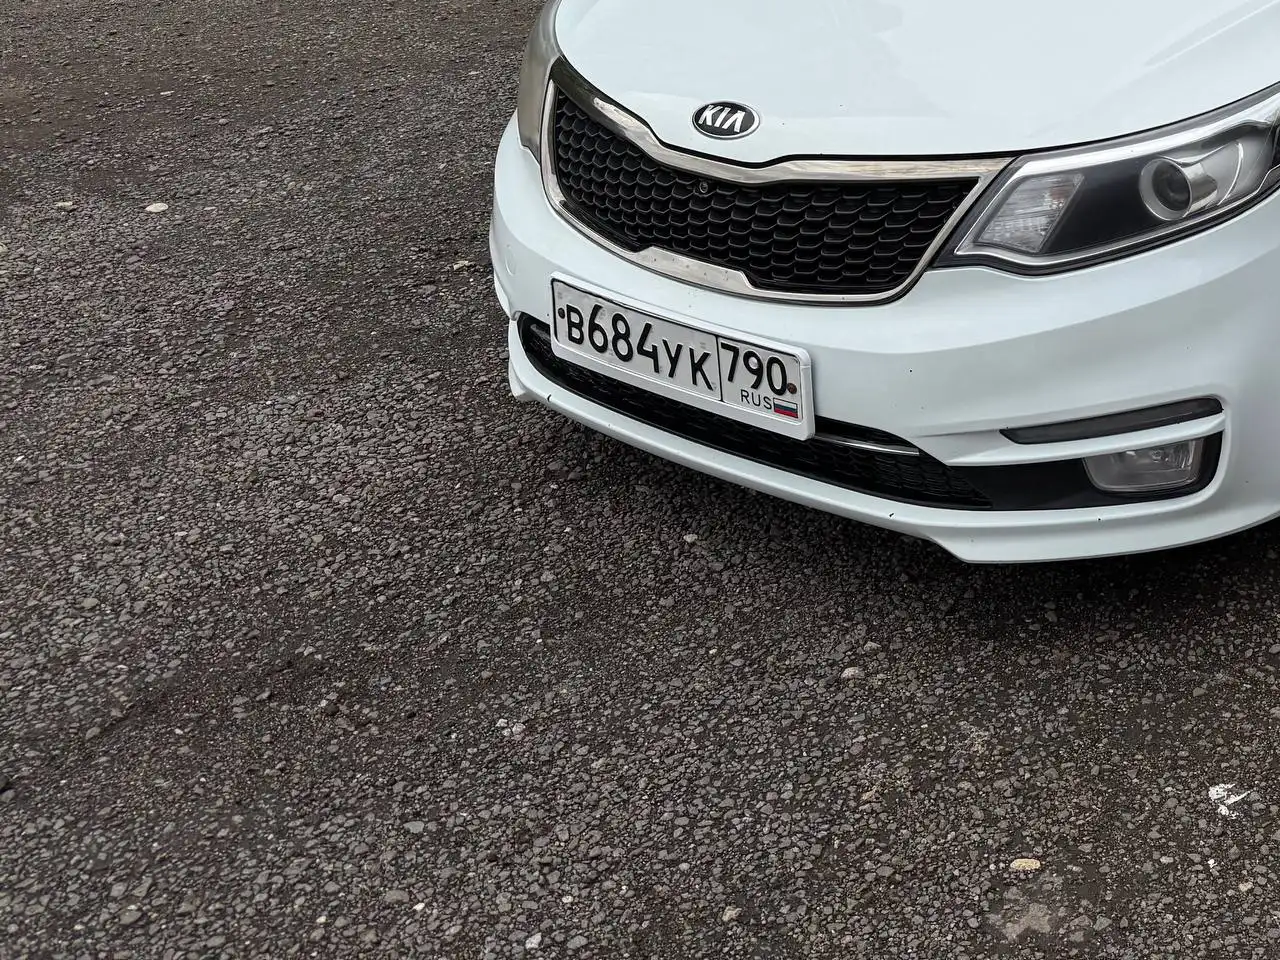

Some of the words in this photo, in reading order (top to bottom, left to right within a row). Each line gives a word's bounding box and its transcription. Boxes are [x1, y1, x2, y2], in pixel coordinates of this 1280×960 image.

[698, 104, 746, 133] KIA
[566, 304, 717, 391] В684УК
[720, 342, 788, 396] 790
[740, 389, 773, 411] RUS
